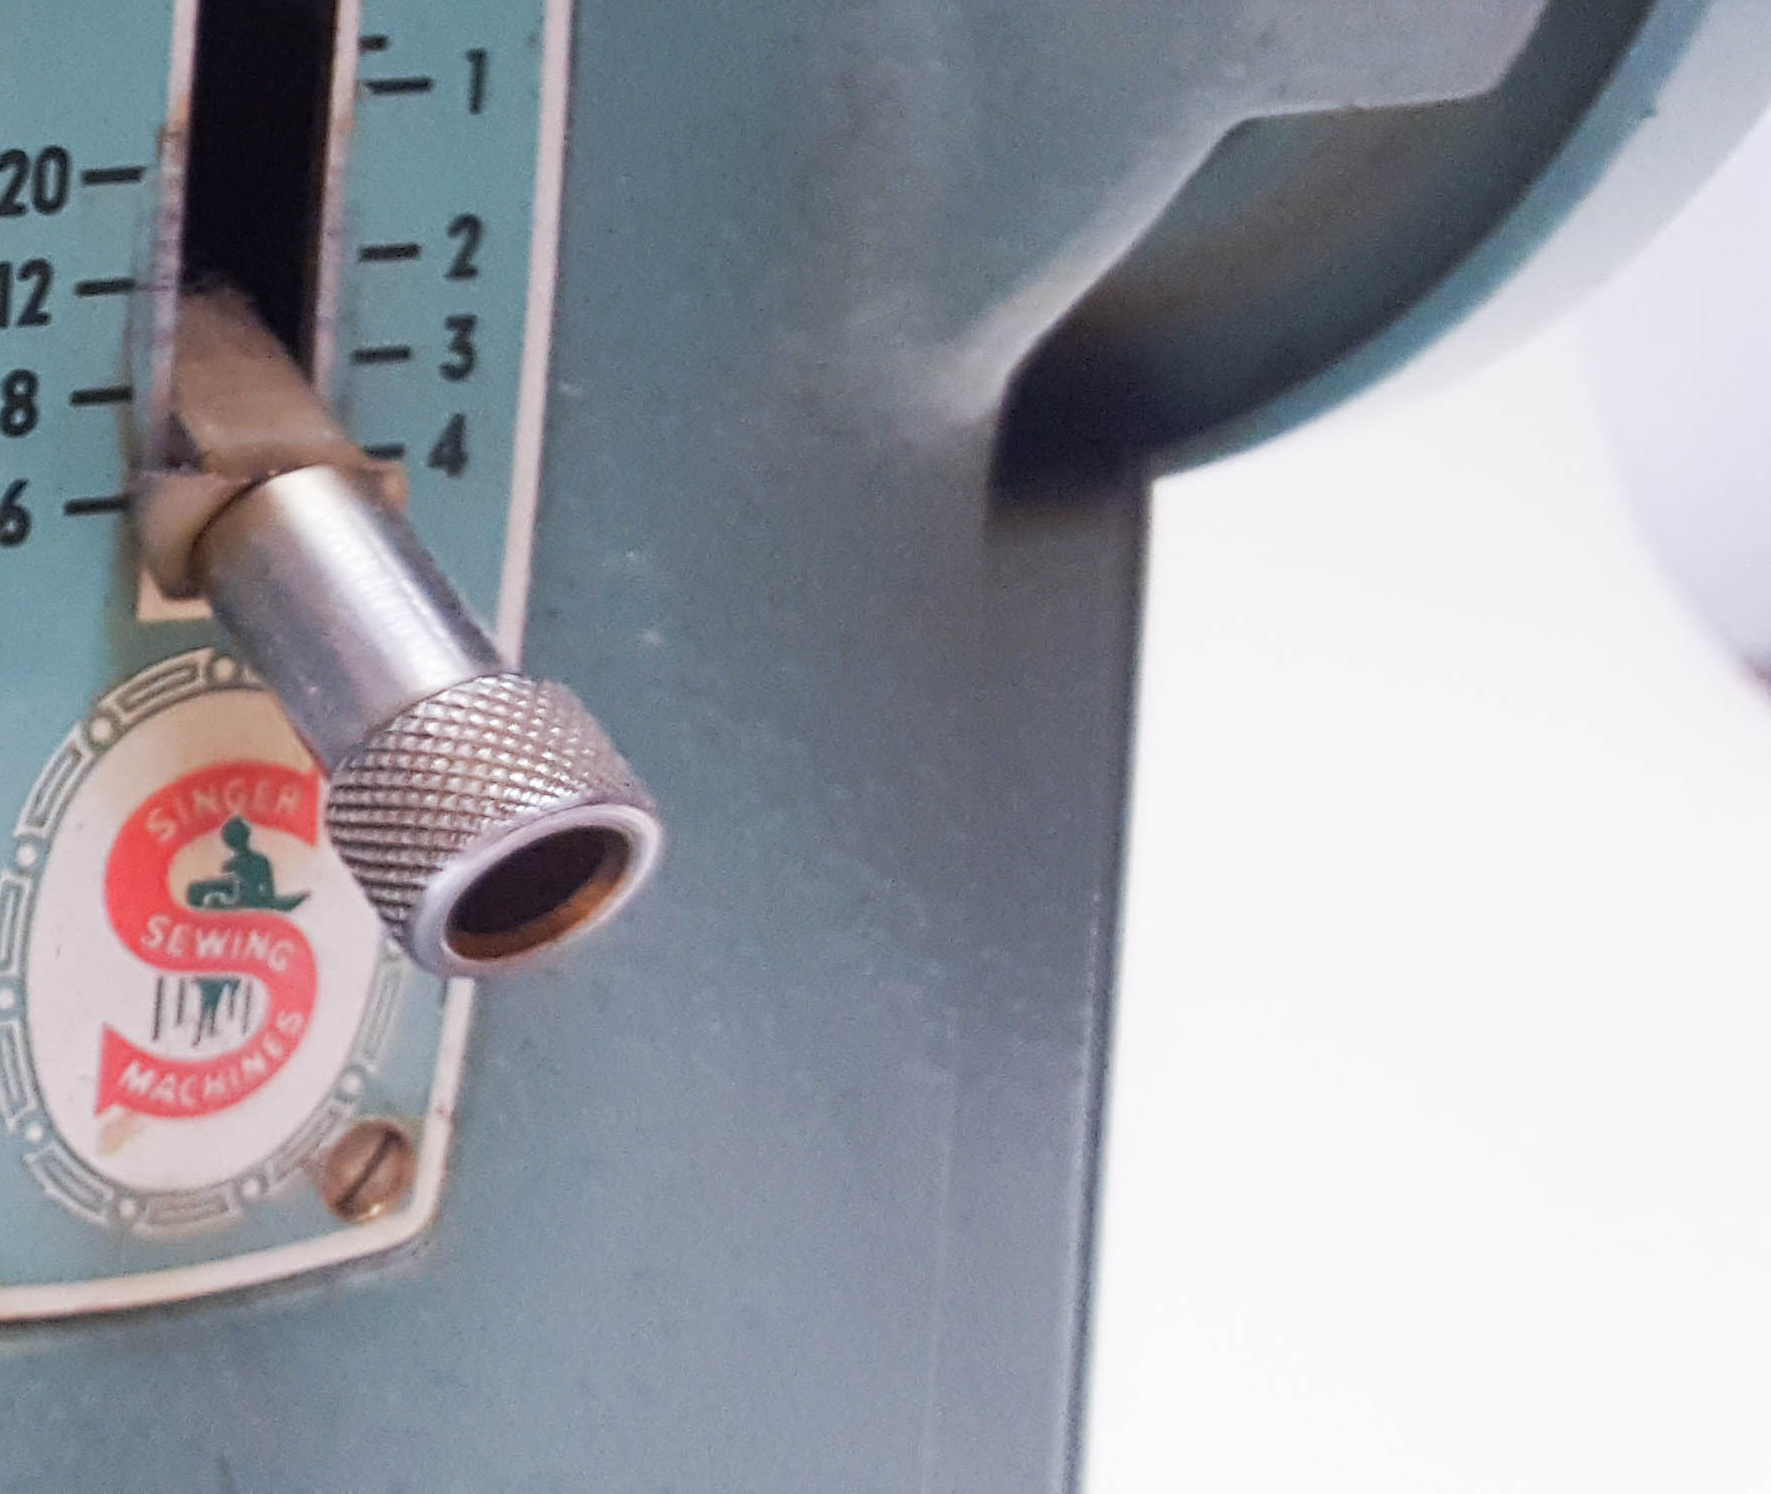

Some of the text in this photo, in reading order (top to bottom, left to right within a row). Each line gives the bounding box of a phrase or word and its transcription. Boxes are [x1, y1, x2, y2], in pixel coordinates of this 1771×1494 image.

[467, 49, 486, 114] 1
[444, 214, 483, 280] 2
[439, 314, 477, 381] 3
[427, 413, 467, 477] 4
[147, 778, 302, 841] SINGER
[139, 915, 296, 974] SEWING
[119, 1009, 304, 1105] MACHINES
